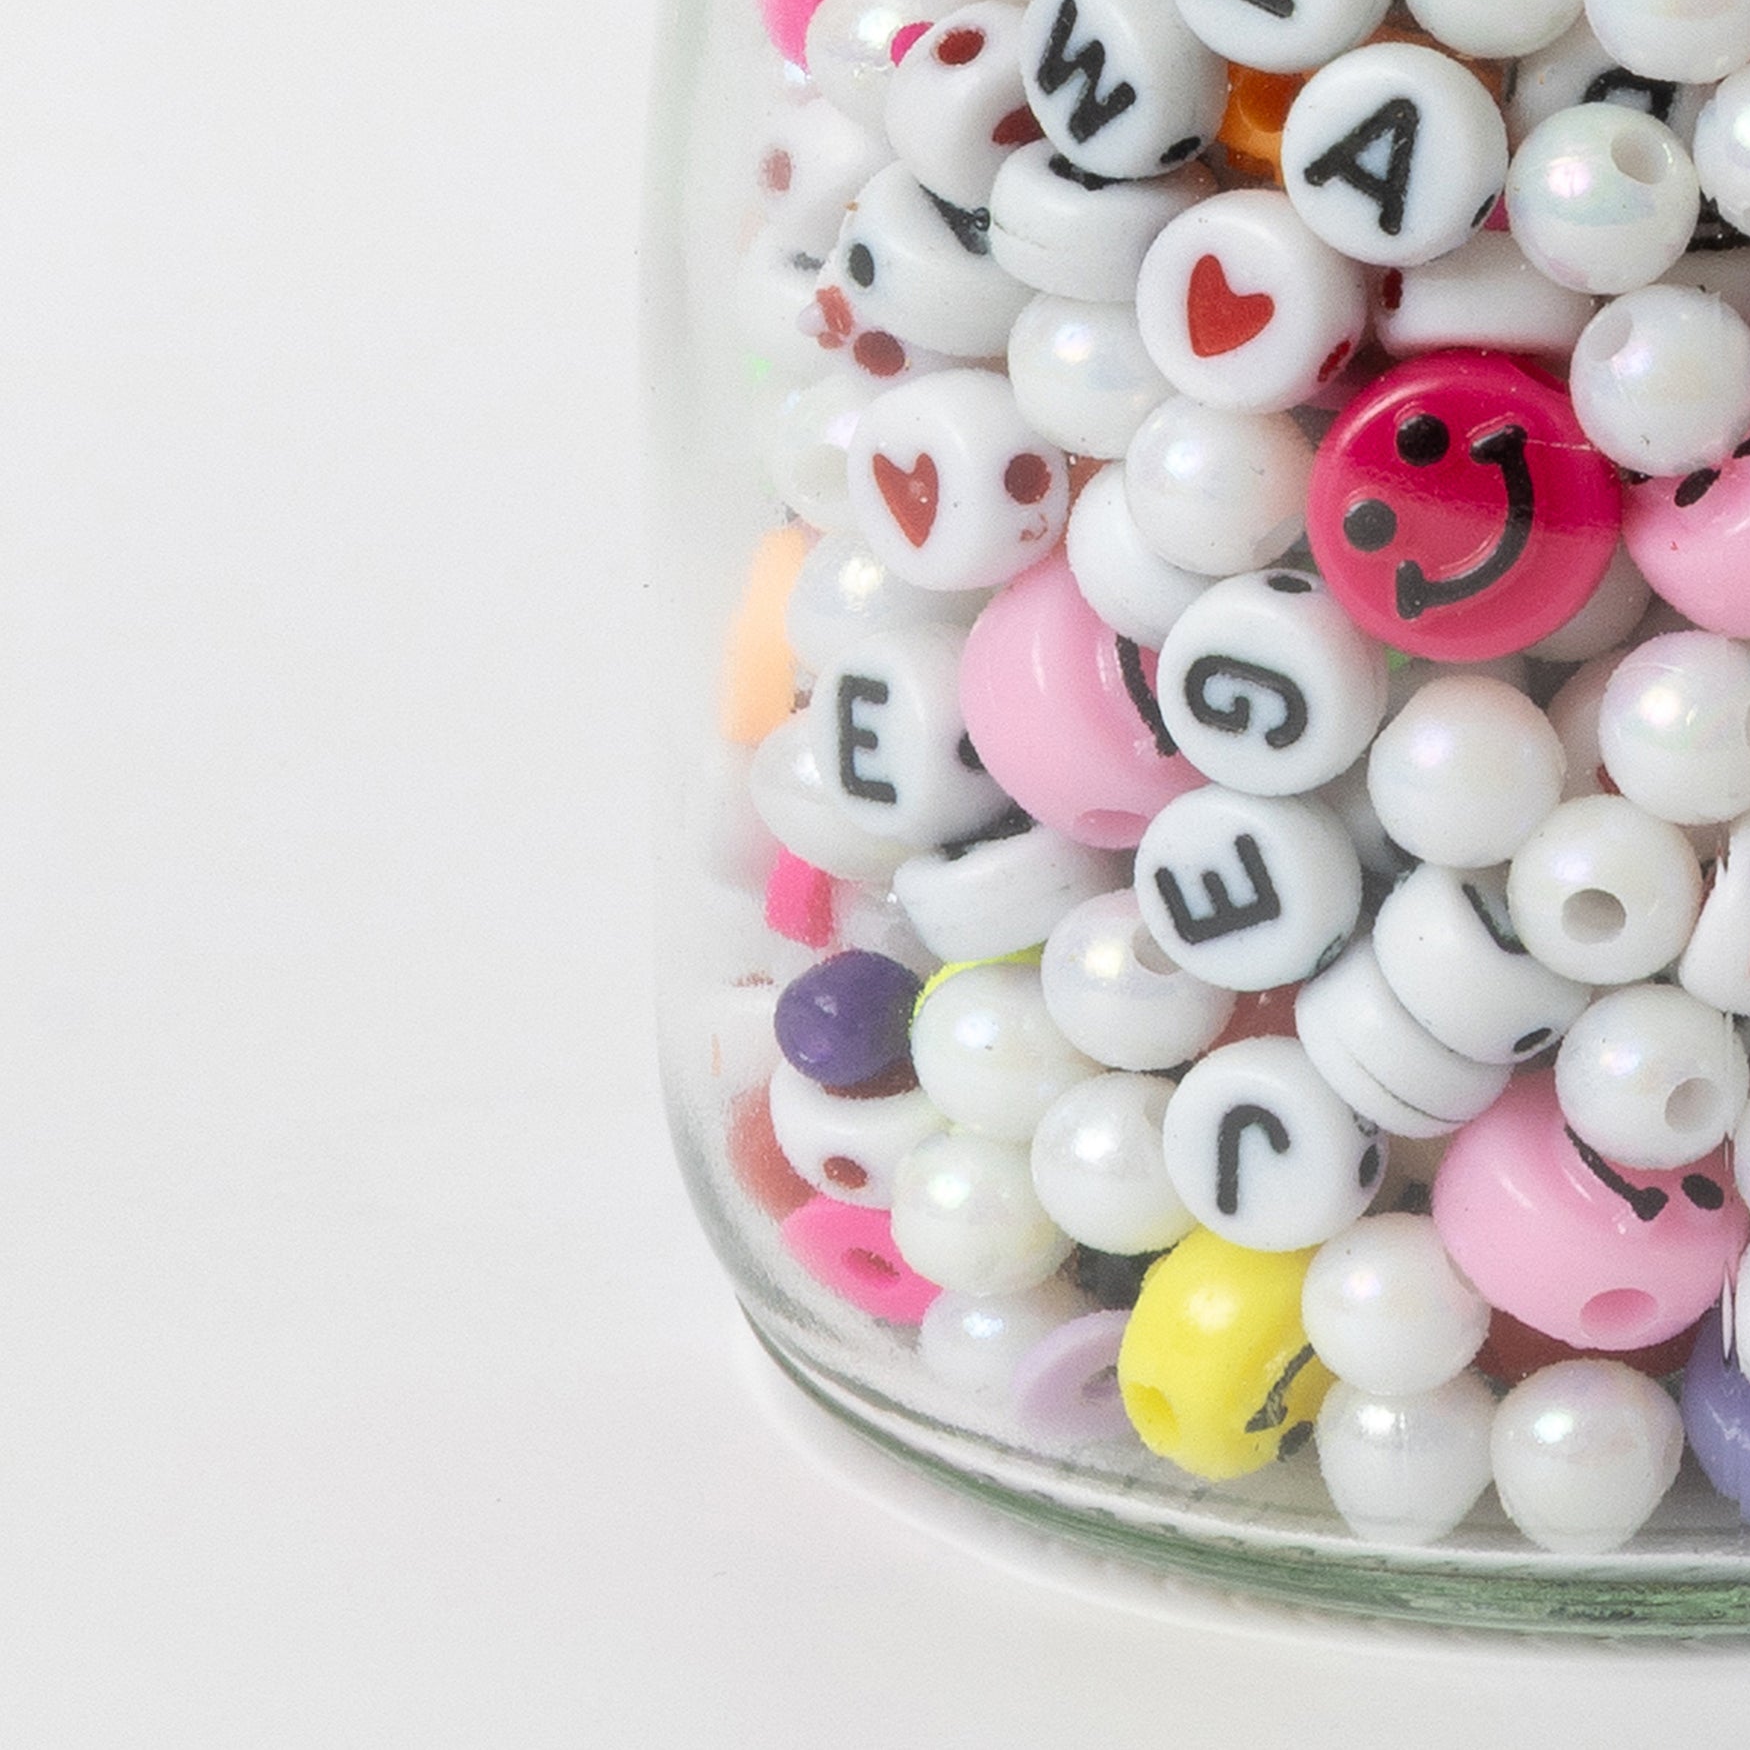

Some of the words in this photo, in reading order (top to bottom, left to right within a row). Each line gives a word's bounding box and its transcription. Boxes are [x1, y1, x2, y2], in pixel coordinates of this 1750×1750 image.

[1304, 99, 1419, 235] A
[838, 675, 896, 804] E
[1185, 655, 1307, 748] G
[1155, 835, 1280, 945] E
